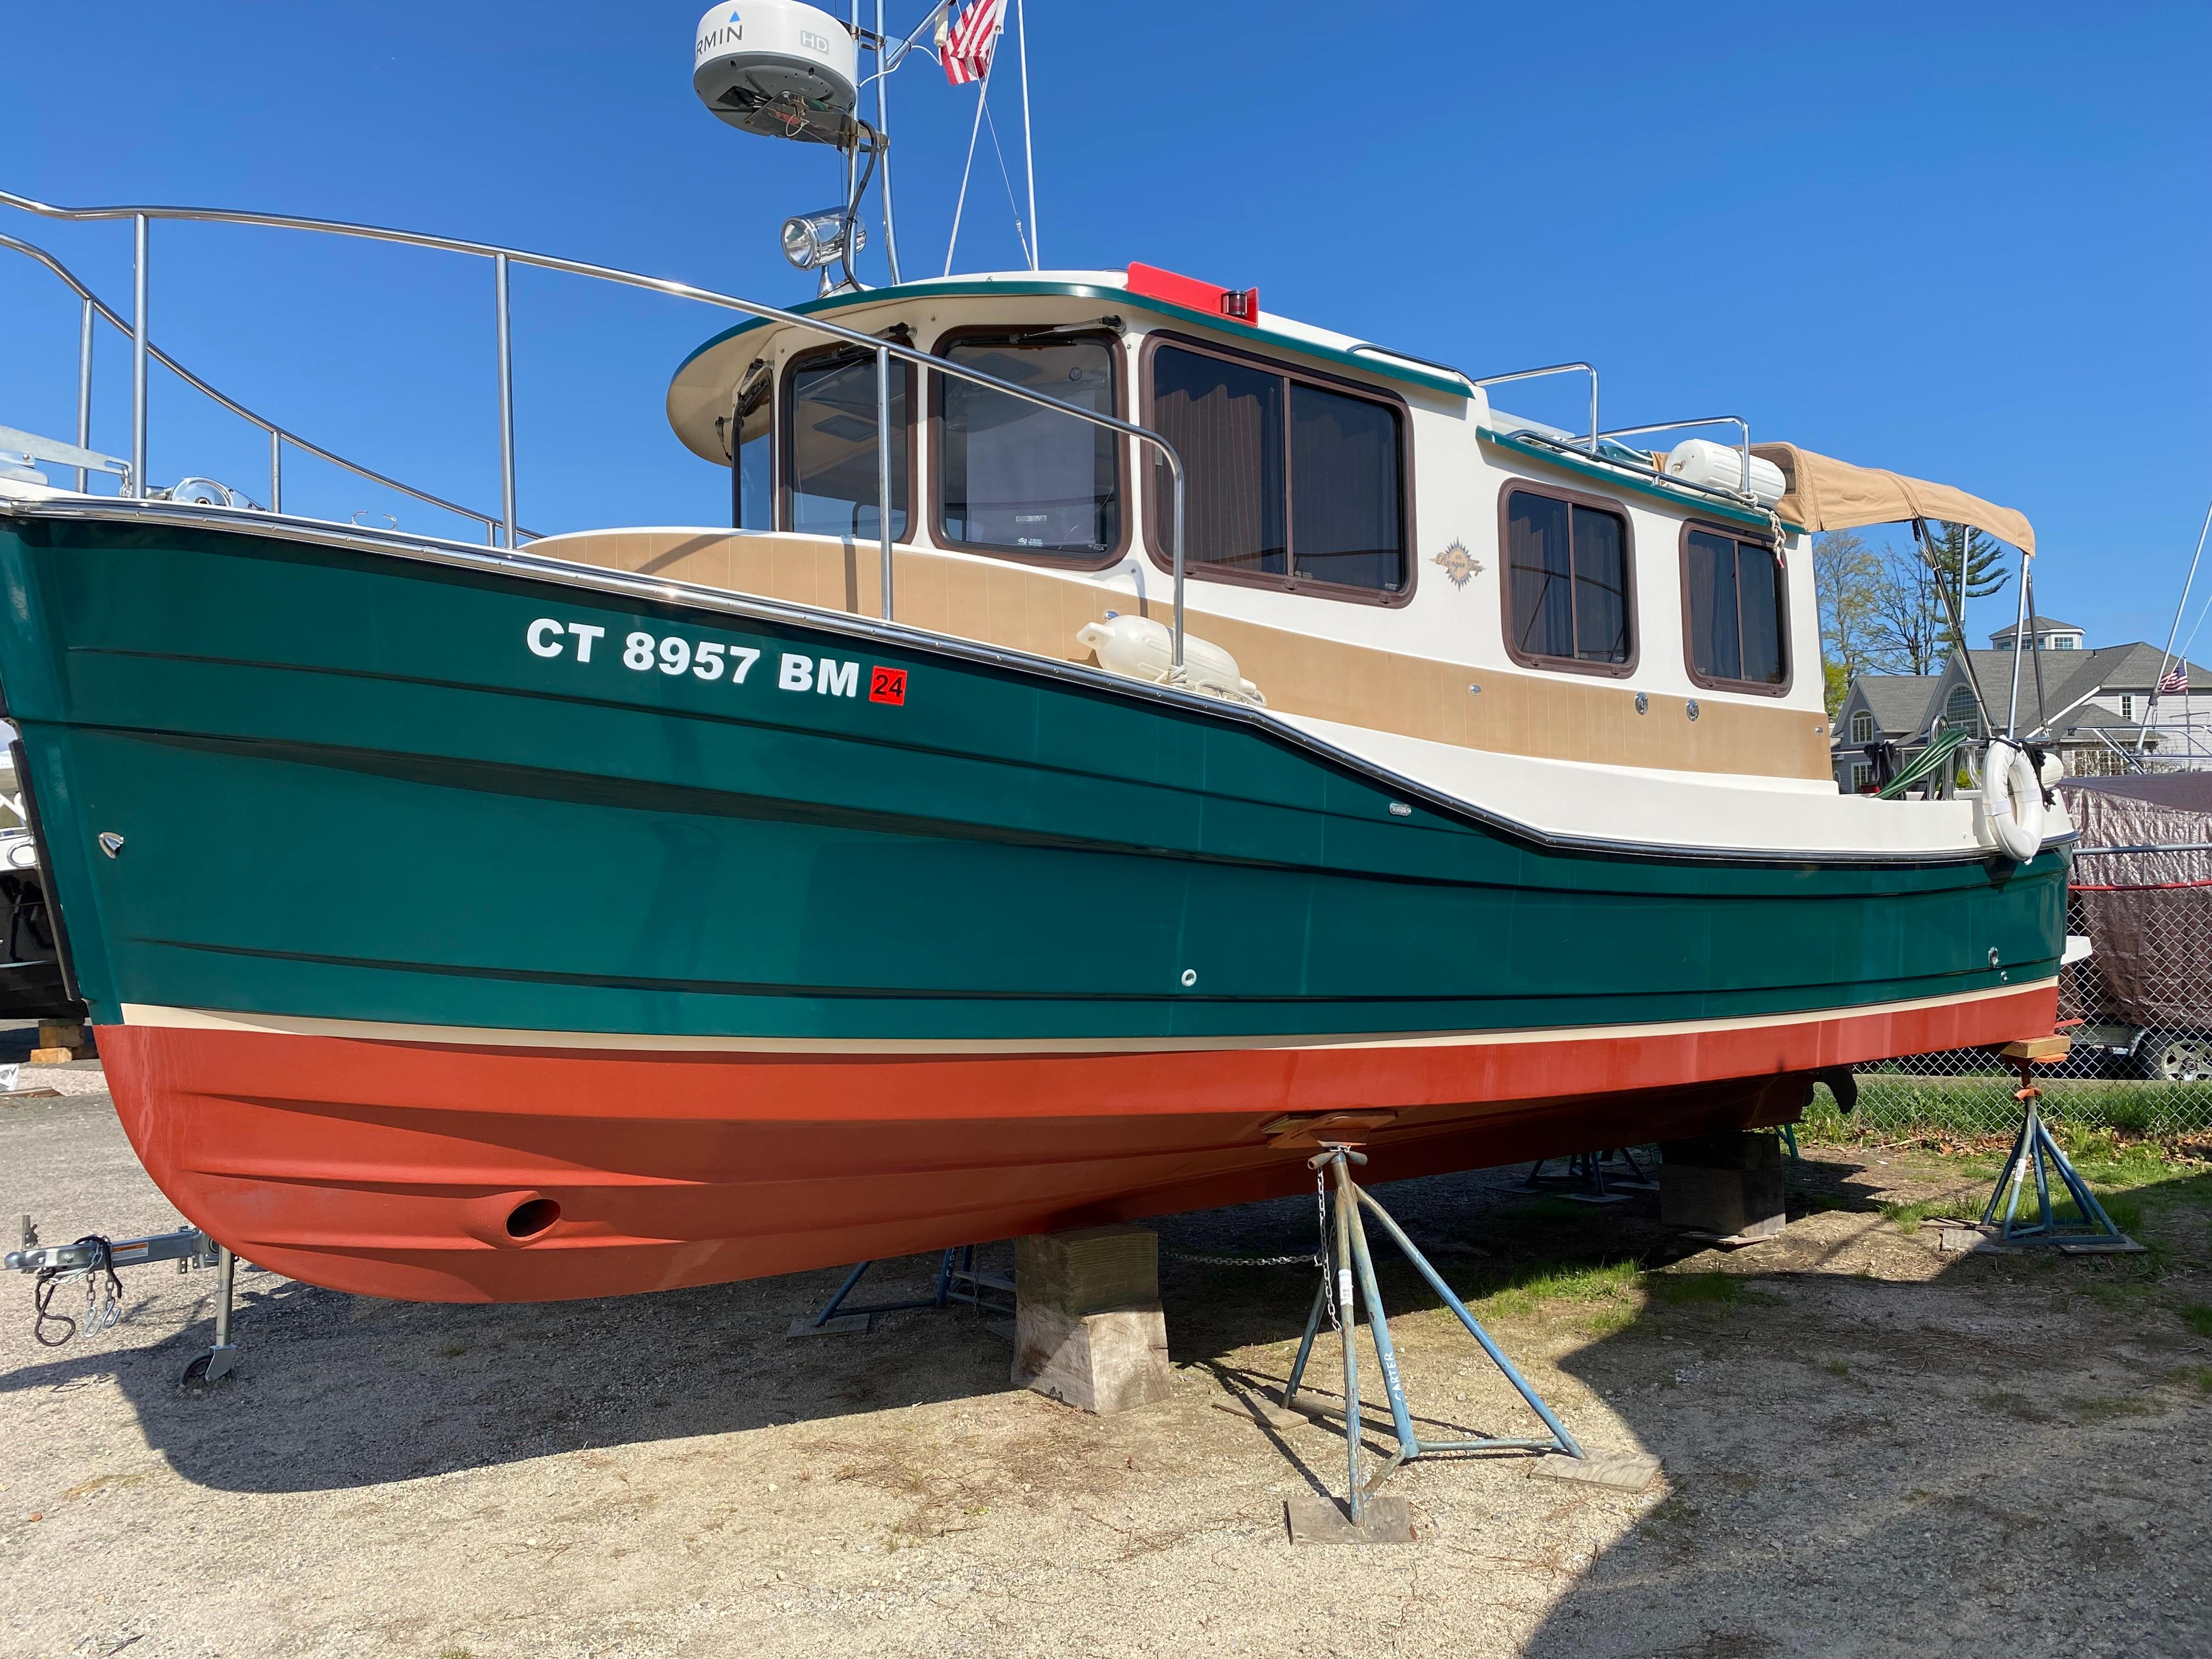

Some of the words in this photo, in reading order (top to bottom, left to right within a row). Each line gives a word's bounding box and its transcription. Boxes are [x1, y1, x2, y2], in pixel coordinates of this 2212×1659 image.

[802, 32, 827, 52] HD
[1436, 552, 1465, 572] Ranger
[1466, 558, 1483, 577] Tugs
[527, 617, 605, 663] CT
[623, 631, 760, 685] 8957
[778, 652, 859, 697] BM
[873, 674, 904, 697] 24
[1384, 1352, 1403, 1401] CARTER
